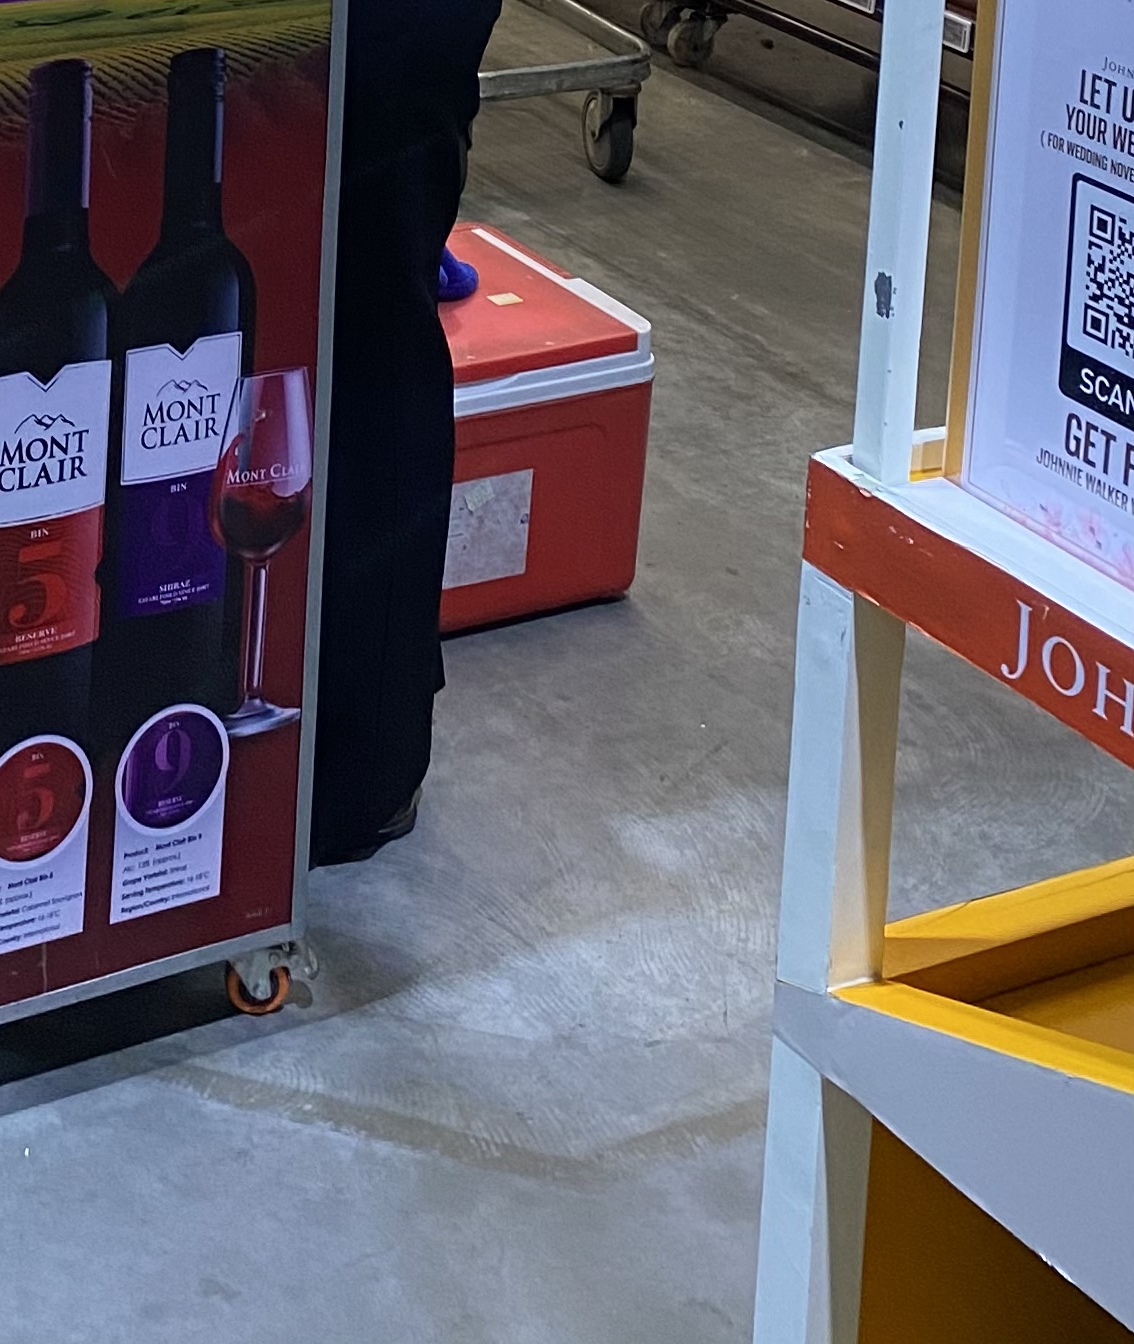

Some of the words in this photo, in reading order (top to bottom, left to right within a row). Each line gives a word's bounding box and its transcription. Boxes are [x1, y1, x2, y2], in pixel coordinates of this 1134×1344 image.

[1079, 69, 1117, 115] LET
[1066, 103, 1107, 146] YOUR
[1066, 140, 1108, 171] WEDDING
[142, 392, 221, 427] MONT
[1079, 368, 1134, 415] SCAN
[0, 429, 89, 467] MONT
[141, 417, 220, 450] CLAIR
[1065, 412, 1117, 476] GET
[170, 482, 188, 494] BIN
[226, 468, 266, 485] MONT
[1036, 448, 1083, 487] JOHNNIE
[1085, 472, 1129, 513] WALKER
[30, 527, 49, 540] BIN
[8, 539, 69, 629] 5
[159, 578, 191, 593] SHIRAZ
[15, 626, 58, 643] RESERVE
[1000, 598, 1134, 738] JOH
[154, 729, 192, 793] 9
[16, 762, 55, 831] 5
